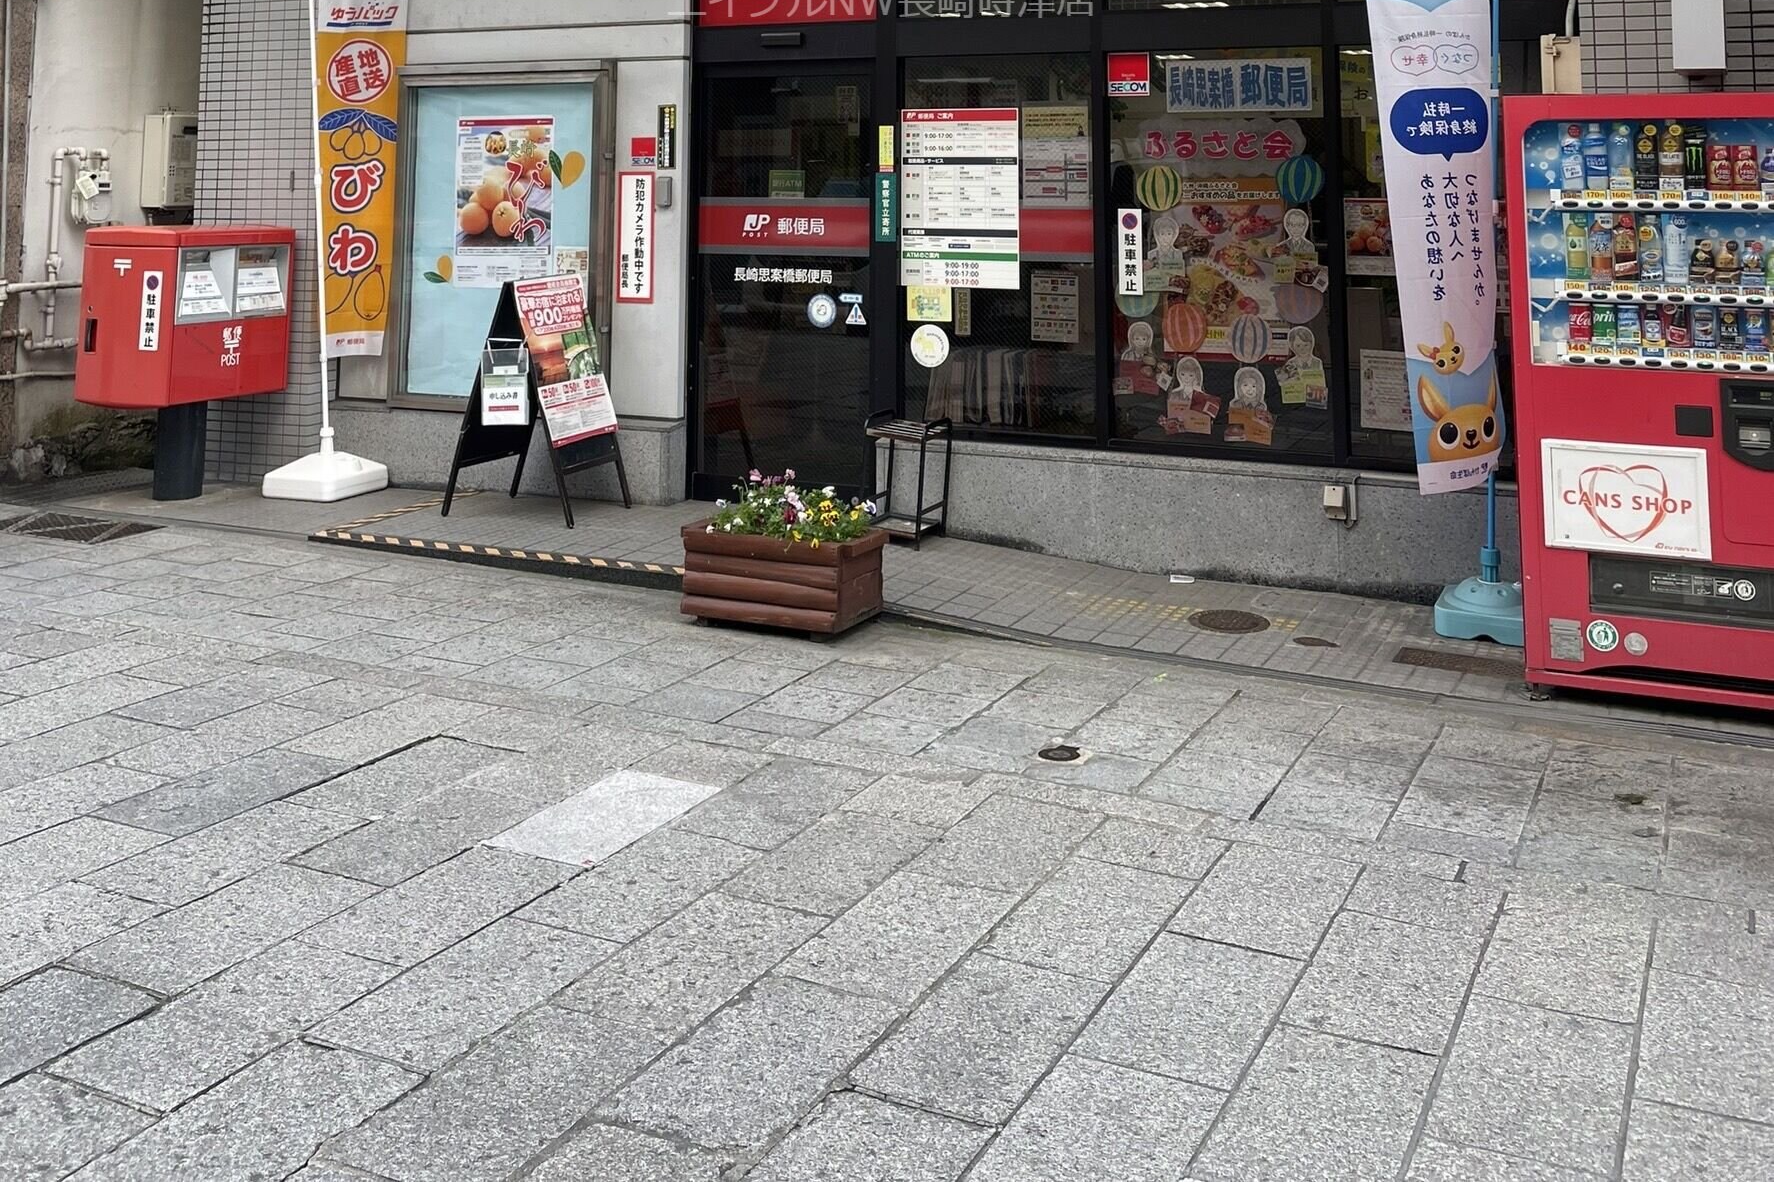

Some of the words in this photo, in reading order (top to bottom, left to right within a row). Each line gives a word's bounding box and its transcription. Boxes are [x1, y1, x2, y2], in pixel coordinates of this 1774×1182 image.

[330, 4, 399, 20] ゆうパック
[1111, 82, 1147, 92] SECOM
[506, 139, 538, 158] 長崎
[1143, 129, 1294, 161] ふるさと会
[505, 159, 549, 242] びわ
[881, 179, 890, 236] 警察官立寄所
[329, 159, 386, 277] びわ
[777, 217, 825, 236] 郵便局
[634, 178, 646, 294] 防犯カメラ作動中です
[621, 254, 629, 289] 郵便局長
[734, 267, 833, 284] 長崎思案橋郵便局
[1124, 233, 1137, 292] 駐車禁止
[143, 294, 157, 348] 駐車禁止
[534, 307, 562, 327] 900
[223, 326, 243, 341] 郵便
[220, 352, 240, 367] POST
[1563, 489, 1623, 509] CANS
[1631, 494, 1693, 515] SHOP
